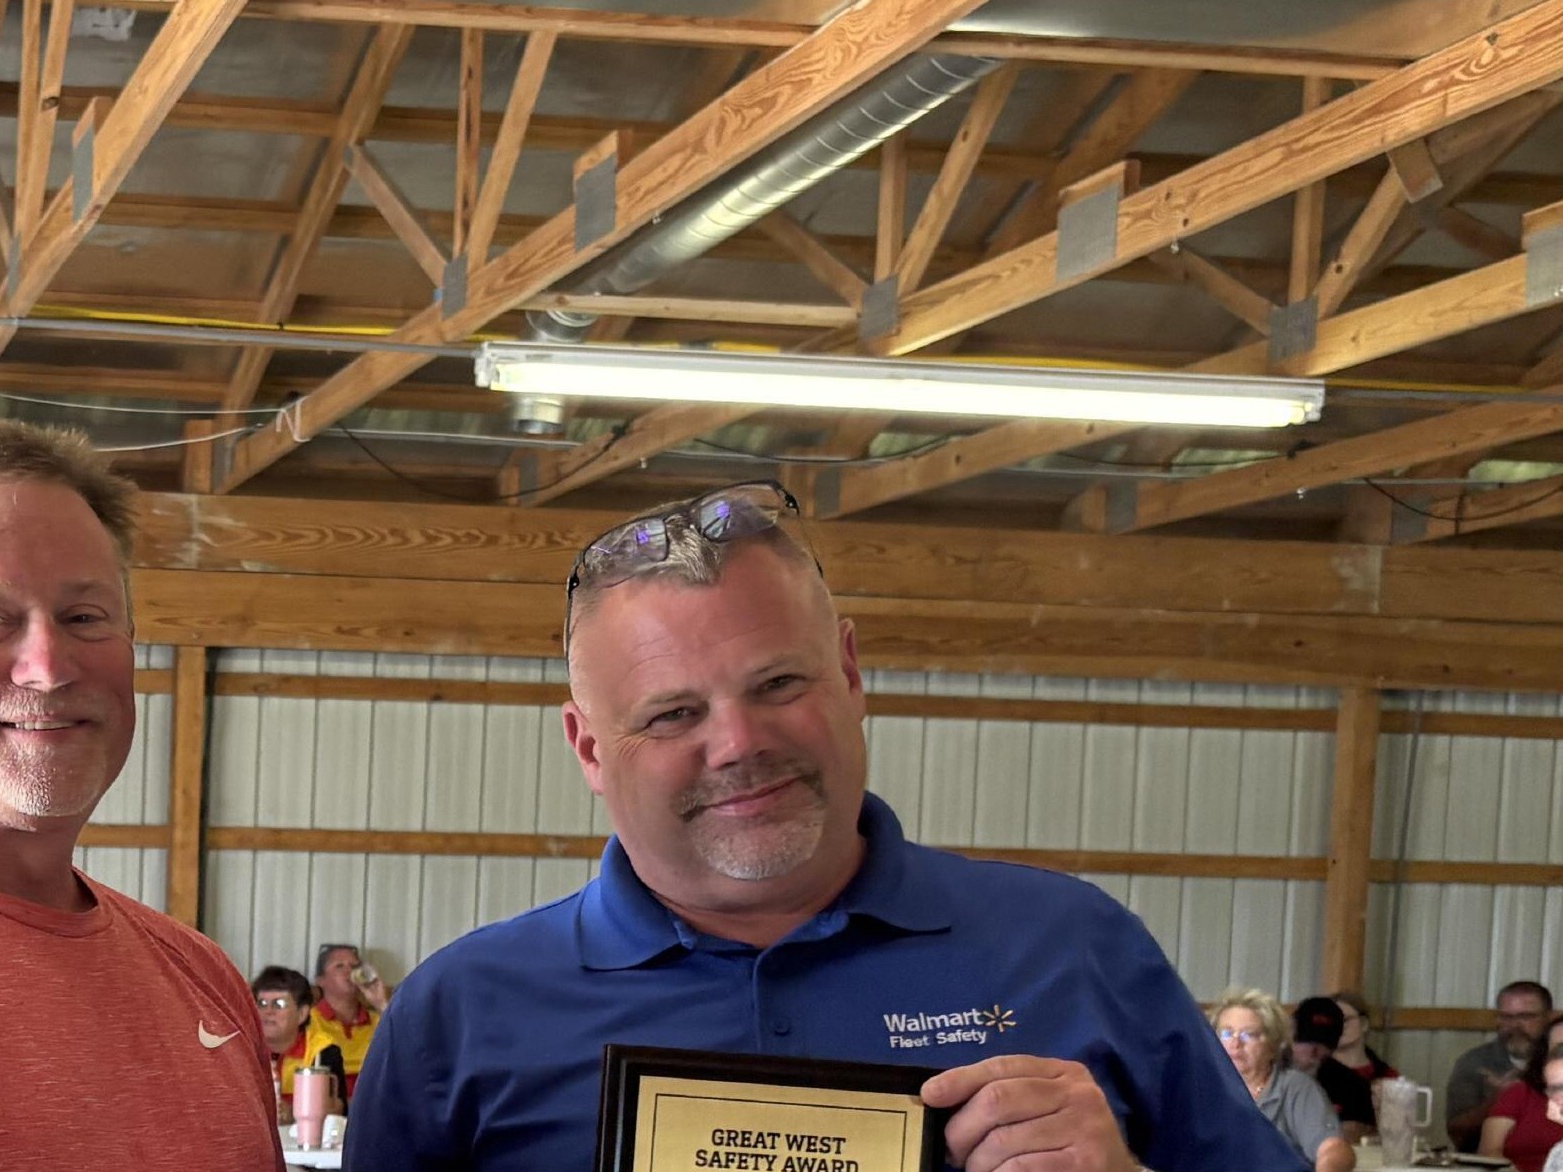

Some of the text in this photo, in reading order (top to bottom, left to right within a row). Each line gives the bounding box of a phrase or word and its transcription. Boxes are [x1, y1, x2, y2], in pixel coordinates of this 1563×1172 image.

[883, 1008, 985, 1032] Walmart
[889, 1029, 987, 1048] Fleet Safety
[711, 1128, 846, 1154] GREAT WEST
[695, 1149, 777, 1172] SAFETY
